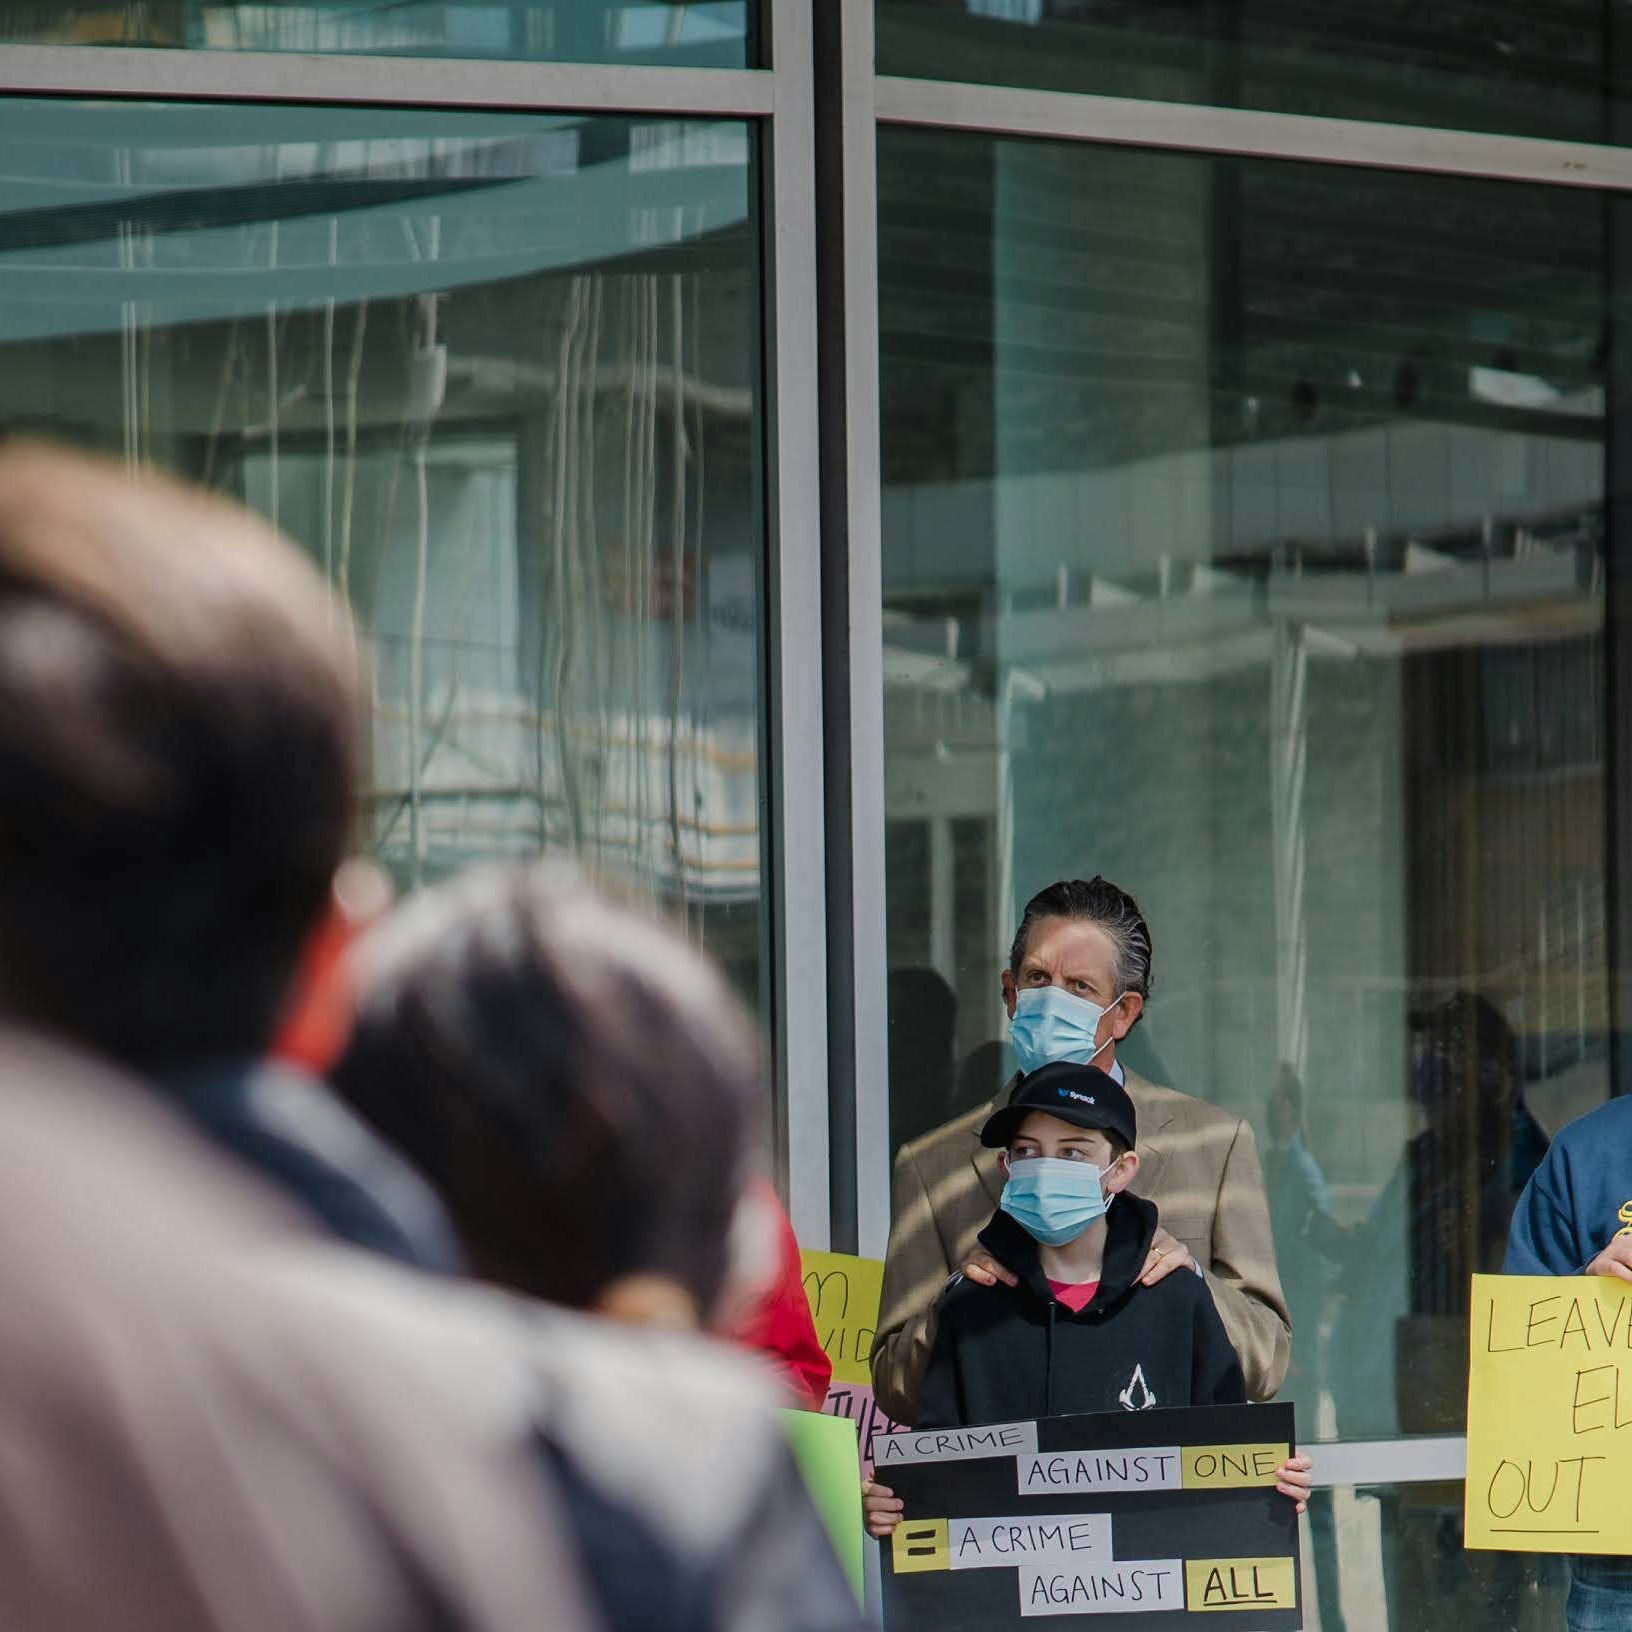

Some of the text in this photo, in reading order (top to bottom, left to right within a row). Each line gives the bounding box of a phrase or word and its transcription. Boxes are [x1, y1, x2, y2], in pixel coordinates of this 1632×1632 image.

[885, 1428, 1023, 1459] A CRIME
[1028, 1452, 1276, 1485] AGAINST ONE
[1488, 1455, 1606, 1523] OUT
[959, 1526, 982, 1557] A
[992, 1523, 1092, 1553] CRIME
[1031, 1566, 1275, 1604] AGAINST ALL
